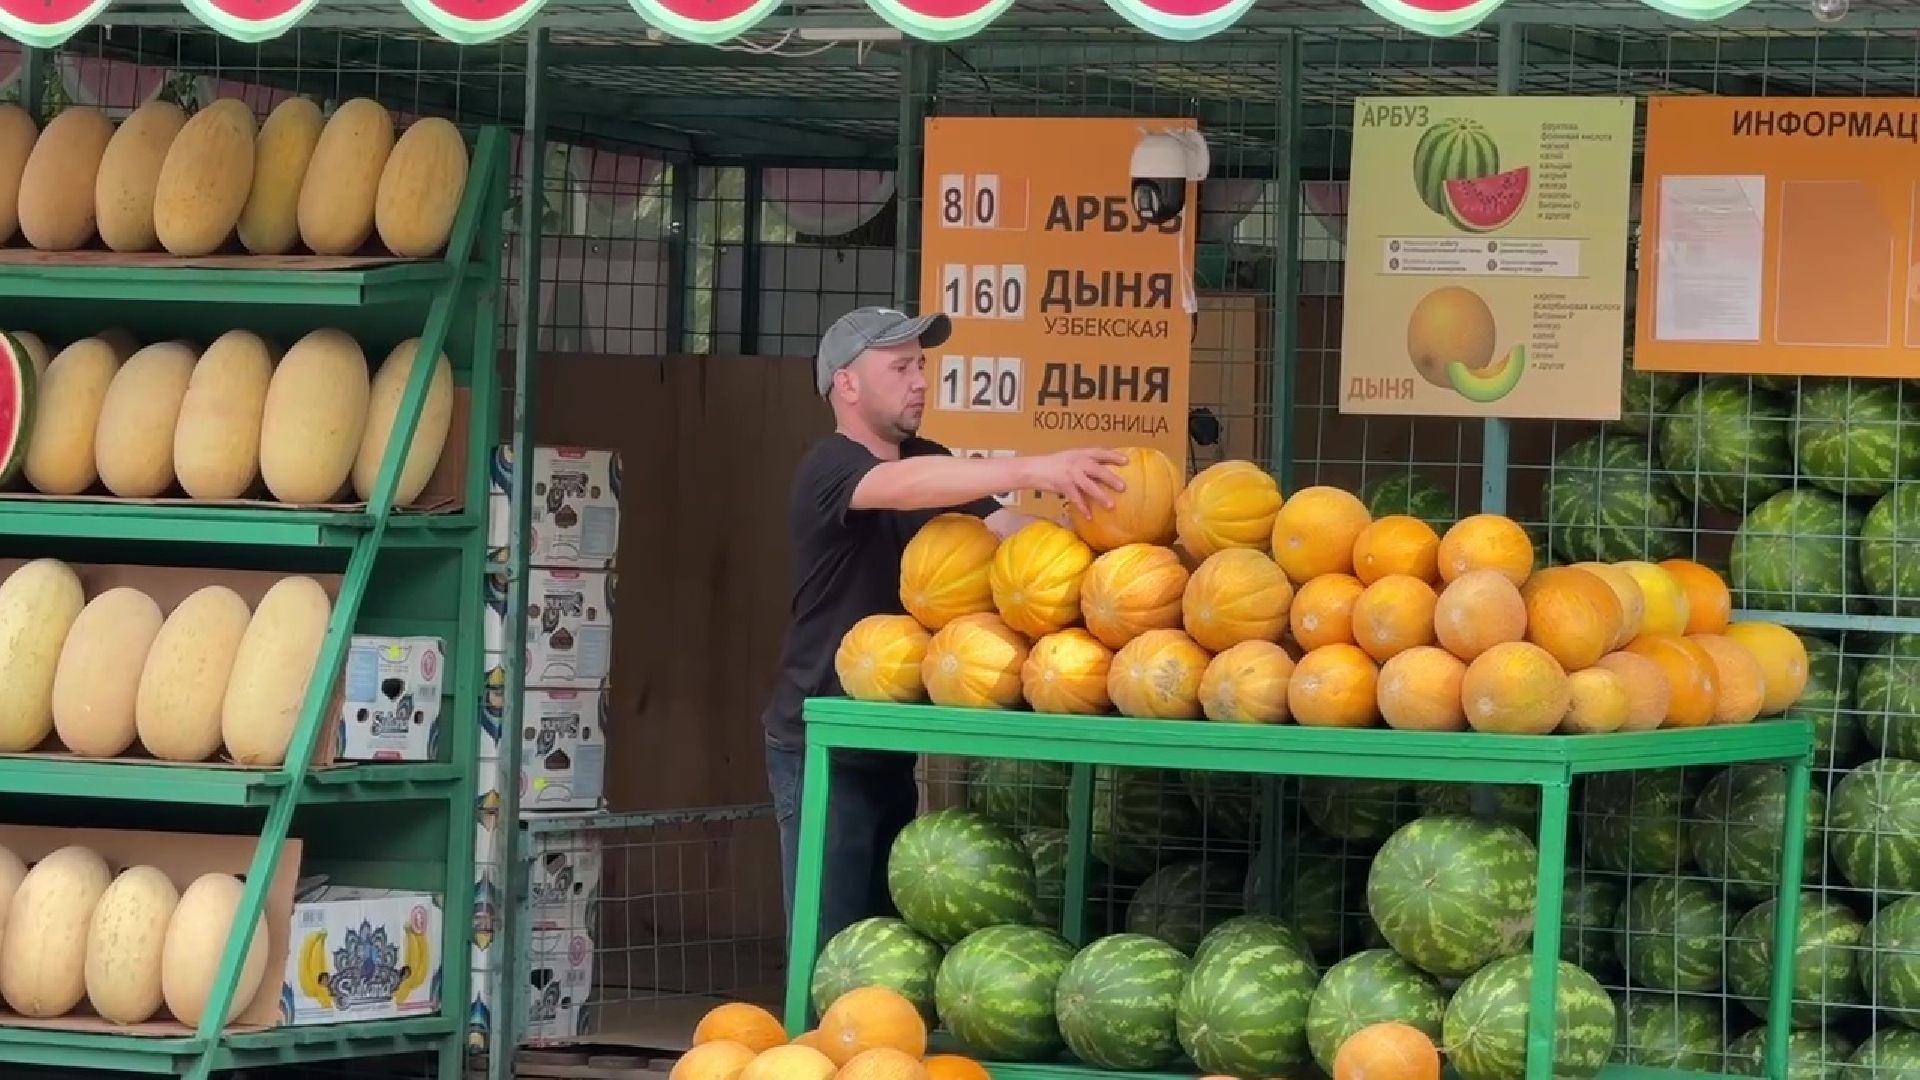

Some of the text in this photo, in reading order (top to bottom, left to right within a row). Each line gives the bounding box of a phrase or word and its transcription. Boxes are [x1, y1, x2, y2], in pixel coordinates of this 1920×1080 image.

[1362, 105, 1429, 127] АРБУЗ
[1733, 110, 1918, 143] ИНФОРМАЦ
[943, 186, 995, 224] 80
[944, 277, 1022, 314] 160
[1040, 270, 1172, 313] ДЫНЯ
[1044, 317, 1169, 338] УЗБЕКСКАЯ
[942, 368, 1018, 407] 120
[1038, 362, 1170, 406] ДЫНЯ
[1347, 378, 1414, 400] ДЫНЯ
[1033, 411, 1169, 436] КОЛХОЗНИЦА
